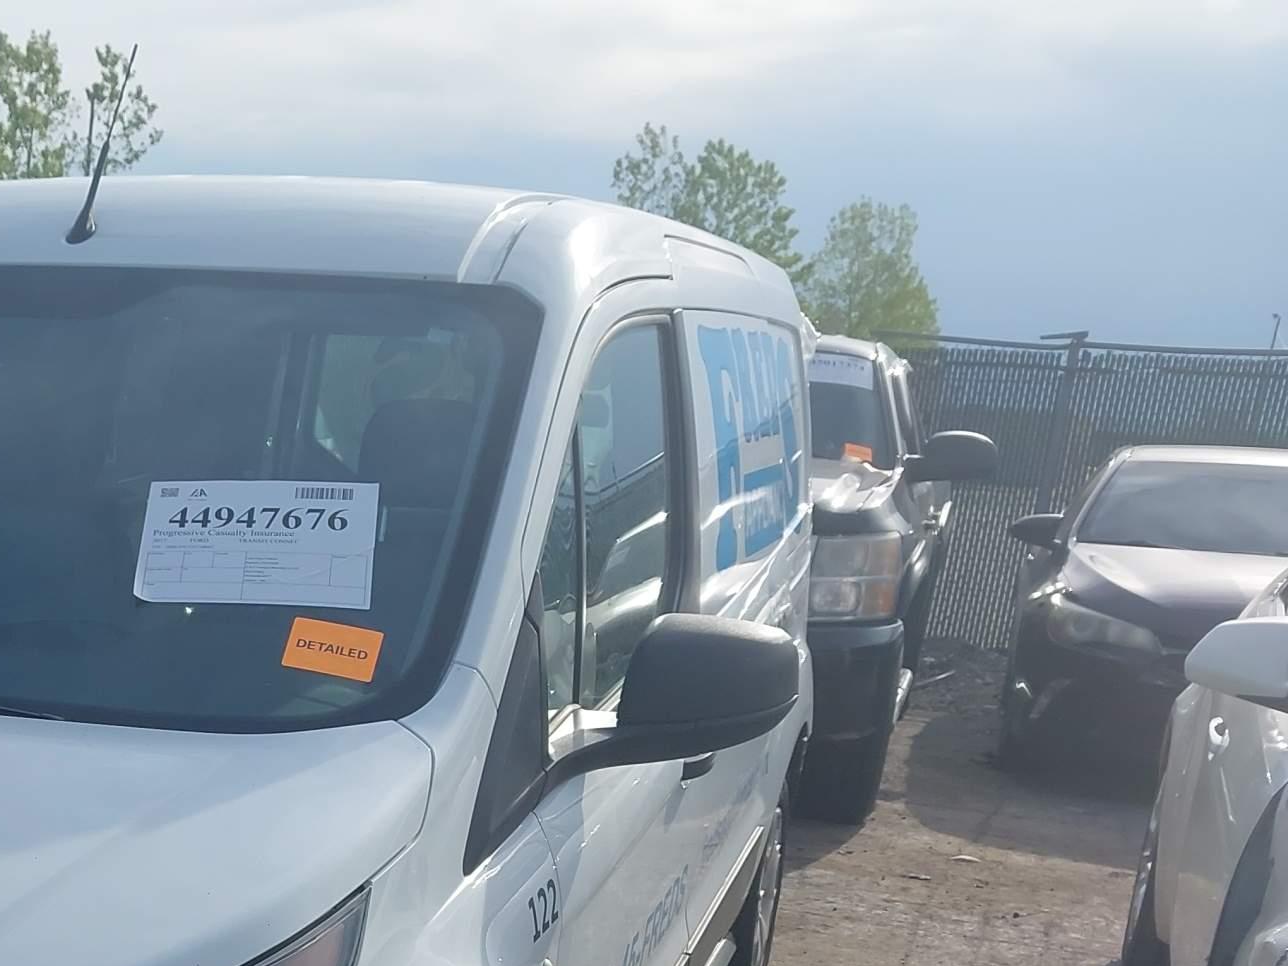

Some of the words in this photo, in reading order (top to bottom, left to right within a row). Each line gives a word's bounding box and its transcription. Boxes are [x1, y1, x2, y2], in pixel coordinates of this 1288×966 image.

[168, 506, 351, 531] 44947676
[153, 529, 205, 538] Progressive
[208, 529, 247, 538] Casualty
[250, 529, 296, 538] Insurance
[296, 638, 369, 661] DETAILED
[527, 878, 559, 944] 122
